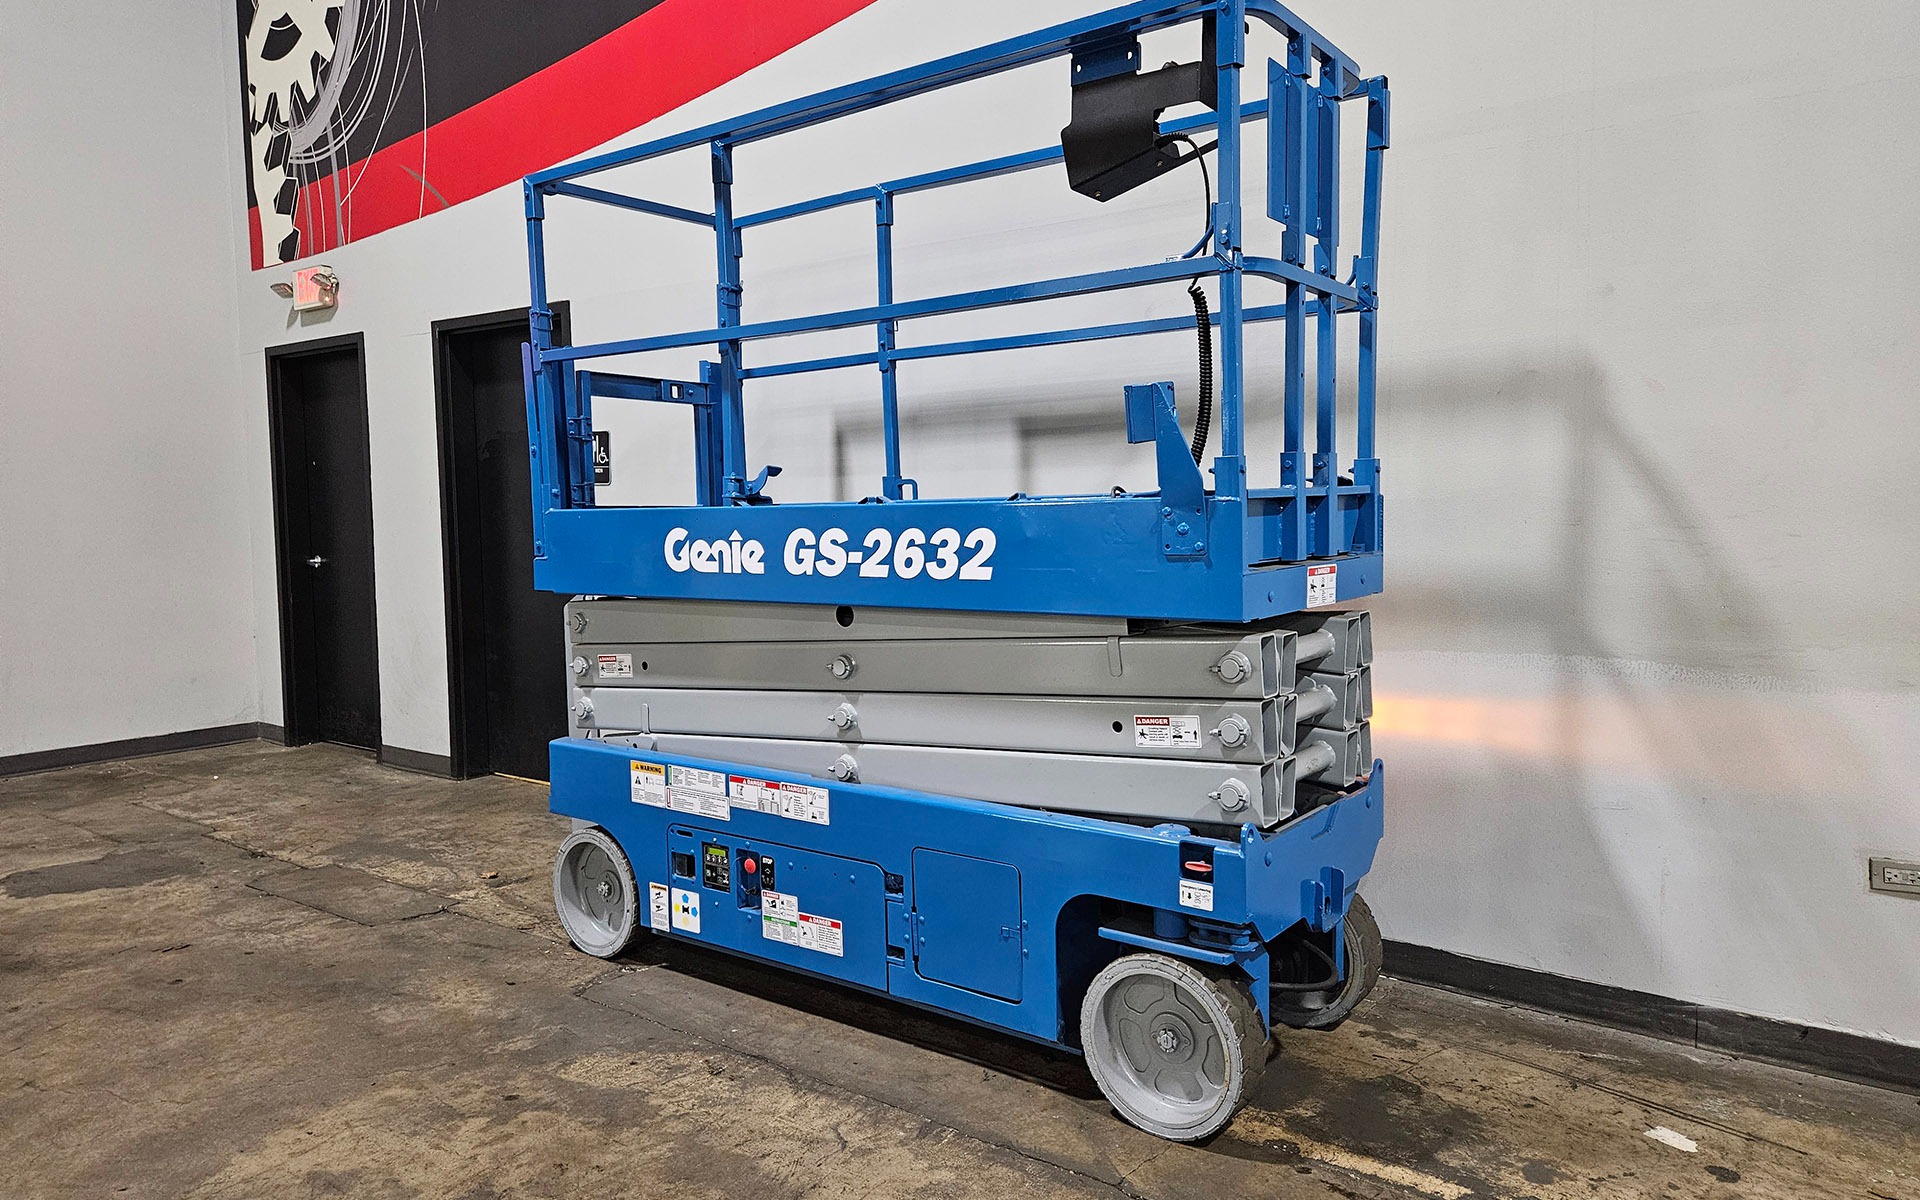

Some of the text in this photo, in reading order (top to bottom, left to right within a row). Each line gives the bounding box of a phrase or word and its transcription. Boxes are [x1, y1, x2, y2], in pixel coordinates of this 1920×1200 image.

[664, 527, 997, 581] Genie GS-2632
[640, 765, 662, 773] WARNING
[746, 778, 767, 788] DANGER
[786, 785, 807, 795] DANGER
[762, 857, 773, 865] STOP
[813, 917, 831, 927] DANGER
